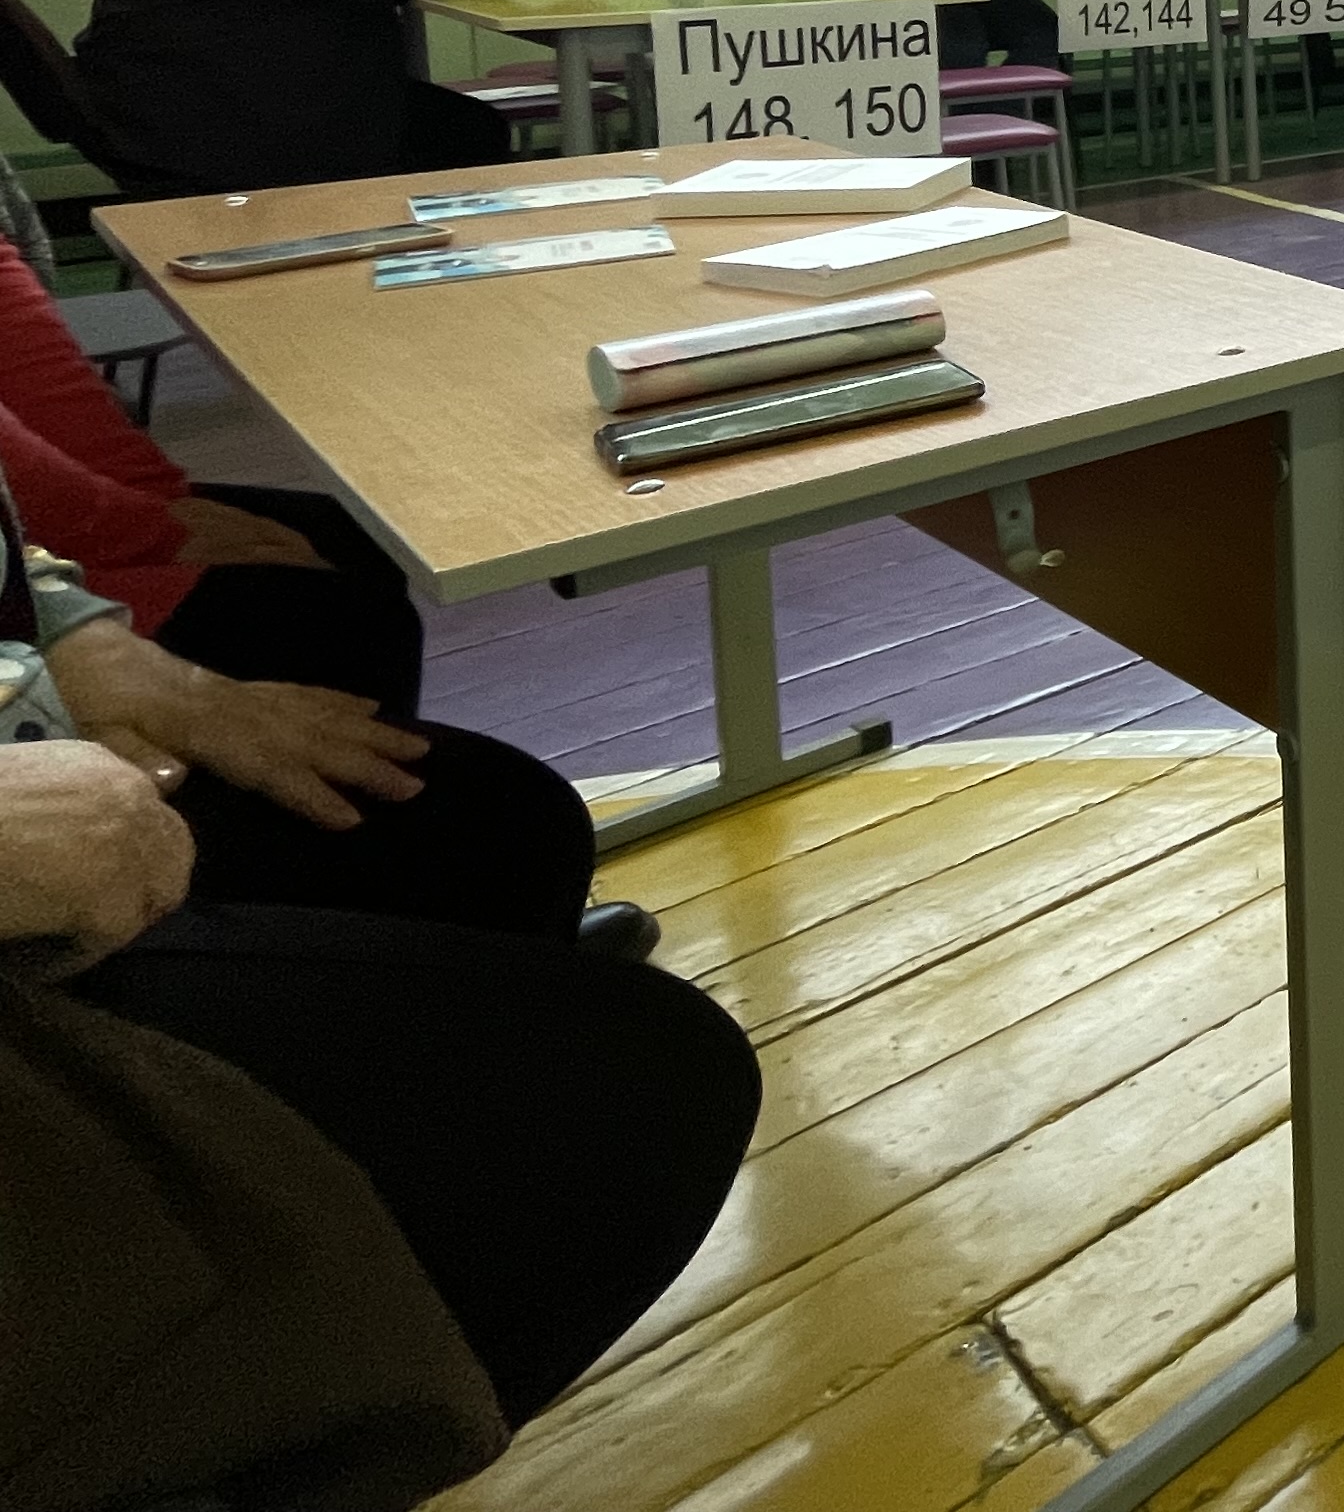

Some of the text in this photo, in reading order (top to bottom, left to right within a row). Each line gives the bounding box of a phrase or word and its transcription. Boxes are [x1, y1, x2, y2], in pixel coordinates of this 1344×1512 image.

[678, 19, 931, 86] Пушкина
[694, 83, 926, 143] 148 150
